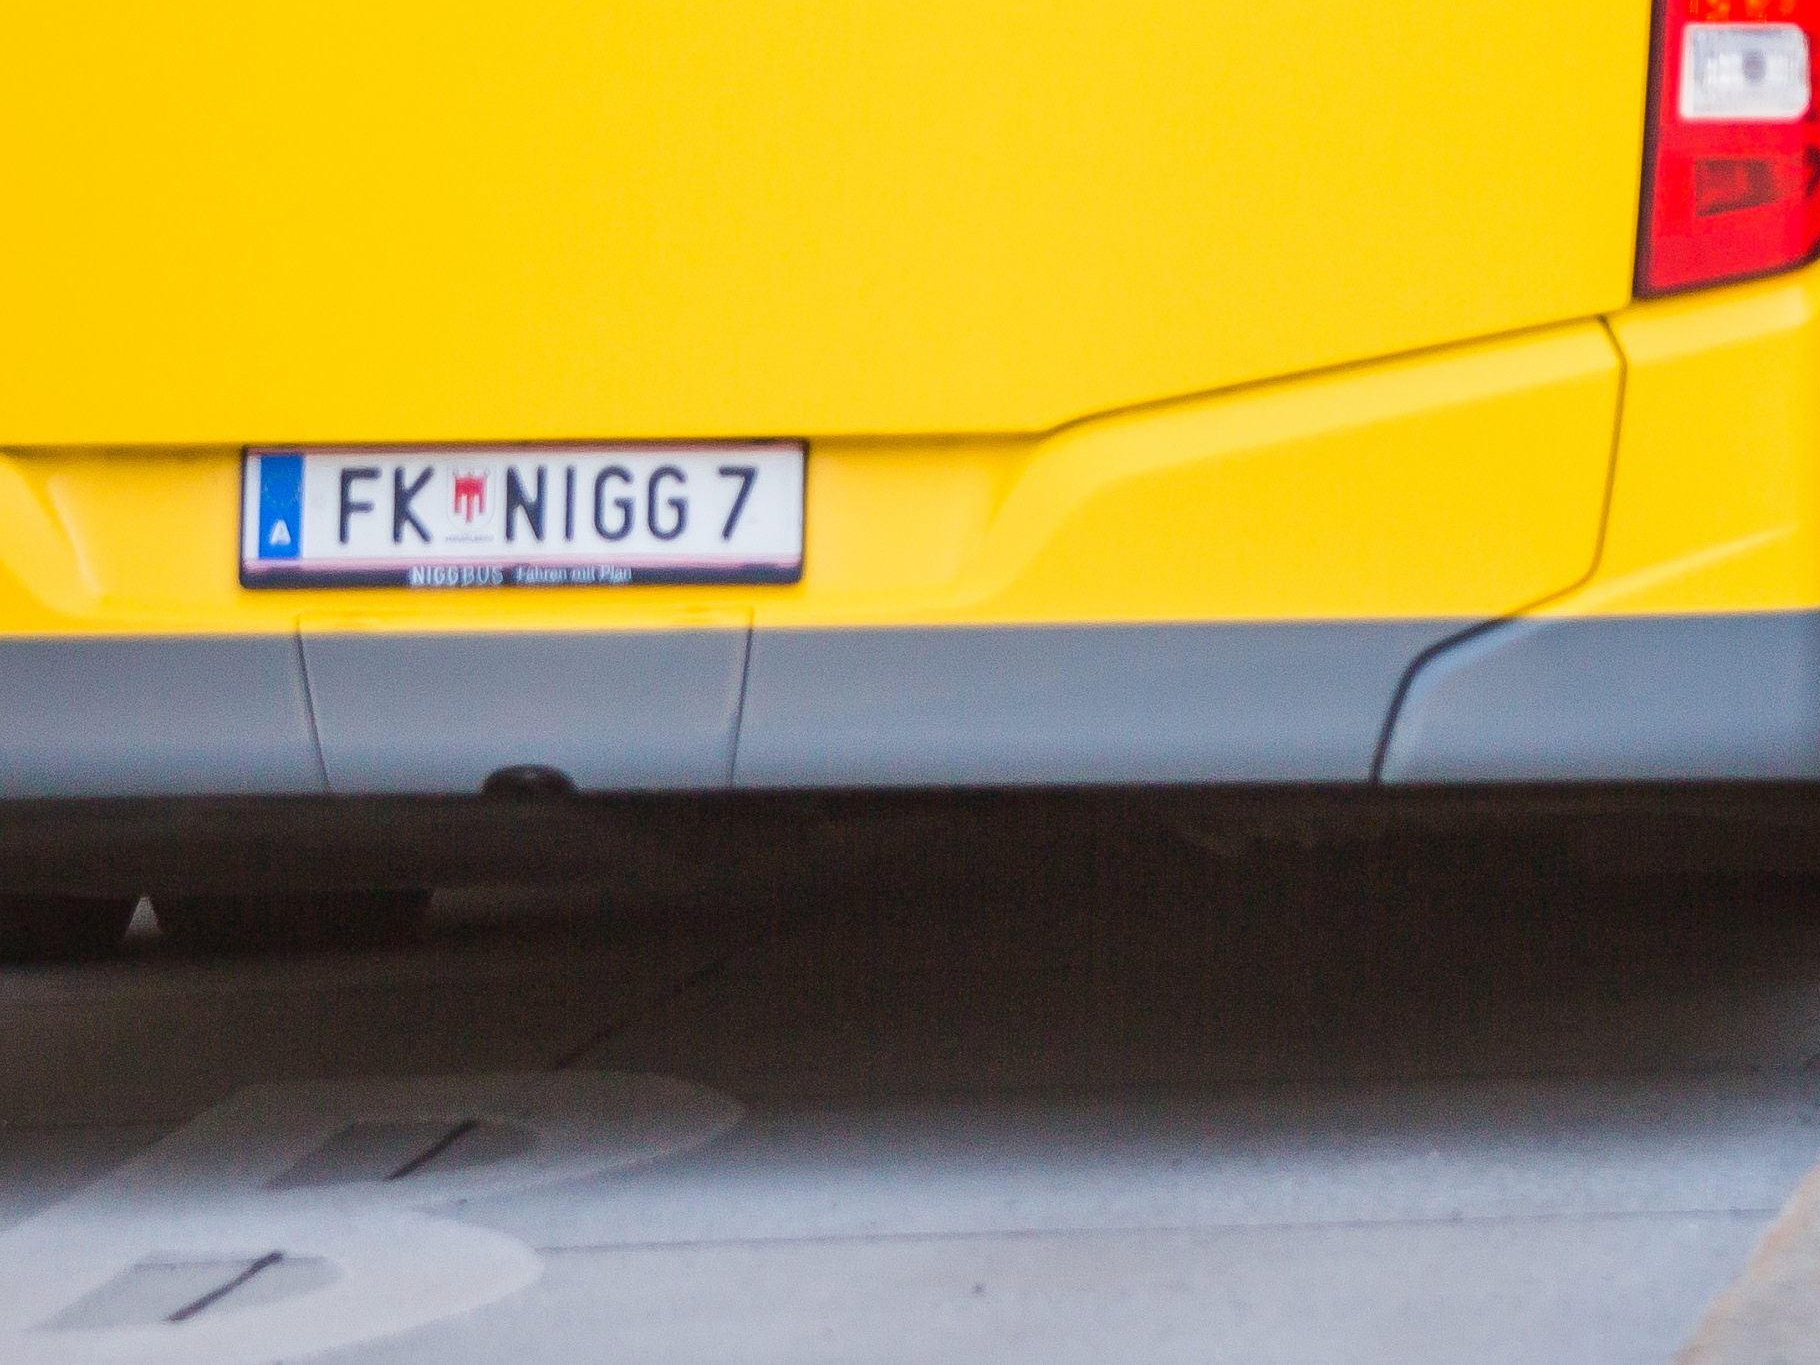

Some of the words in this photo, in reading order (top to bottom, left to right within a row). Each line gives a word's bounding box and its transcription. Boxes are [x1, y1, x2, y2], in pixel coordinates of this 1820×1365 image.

[338, 465, 435, 545] FK
[504, 464, 689, 543] NIGG
[718, 465, 761, 541] 7
